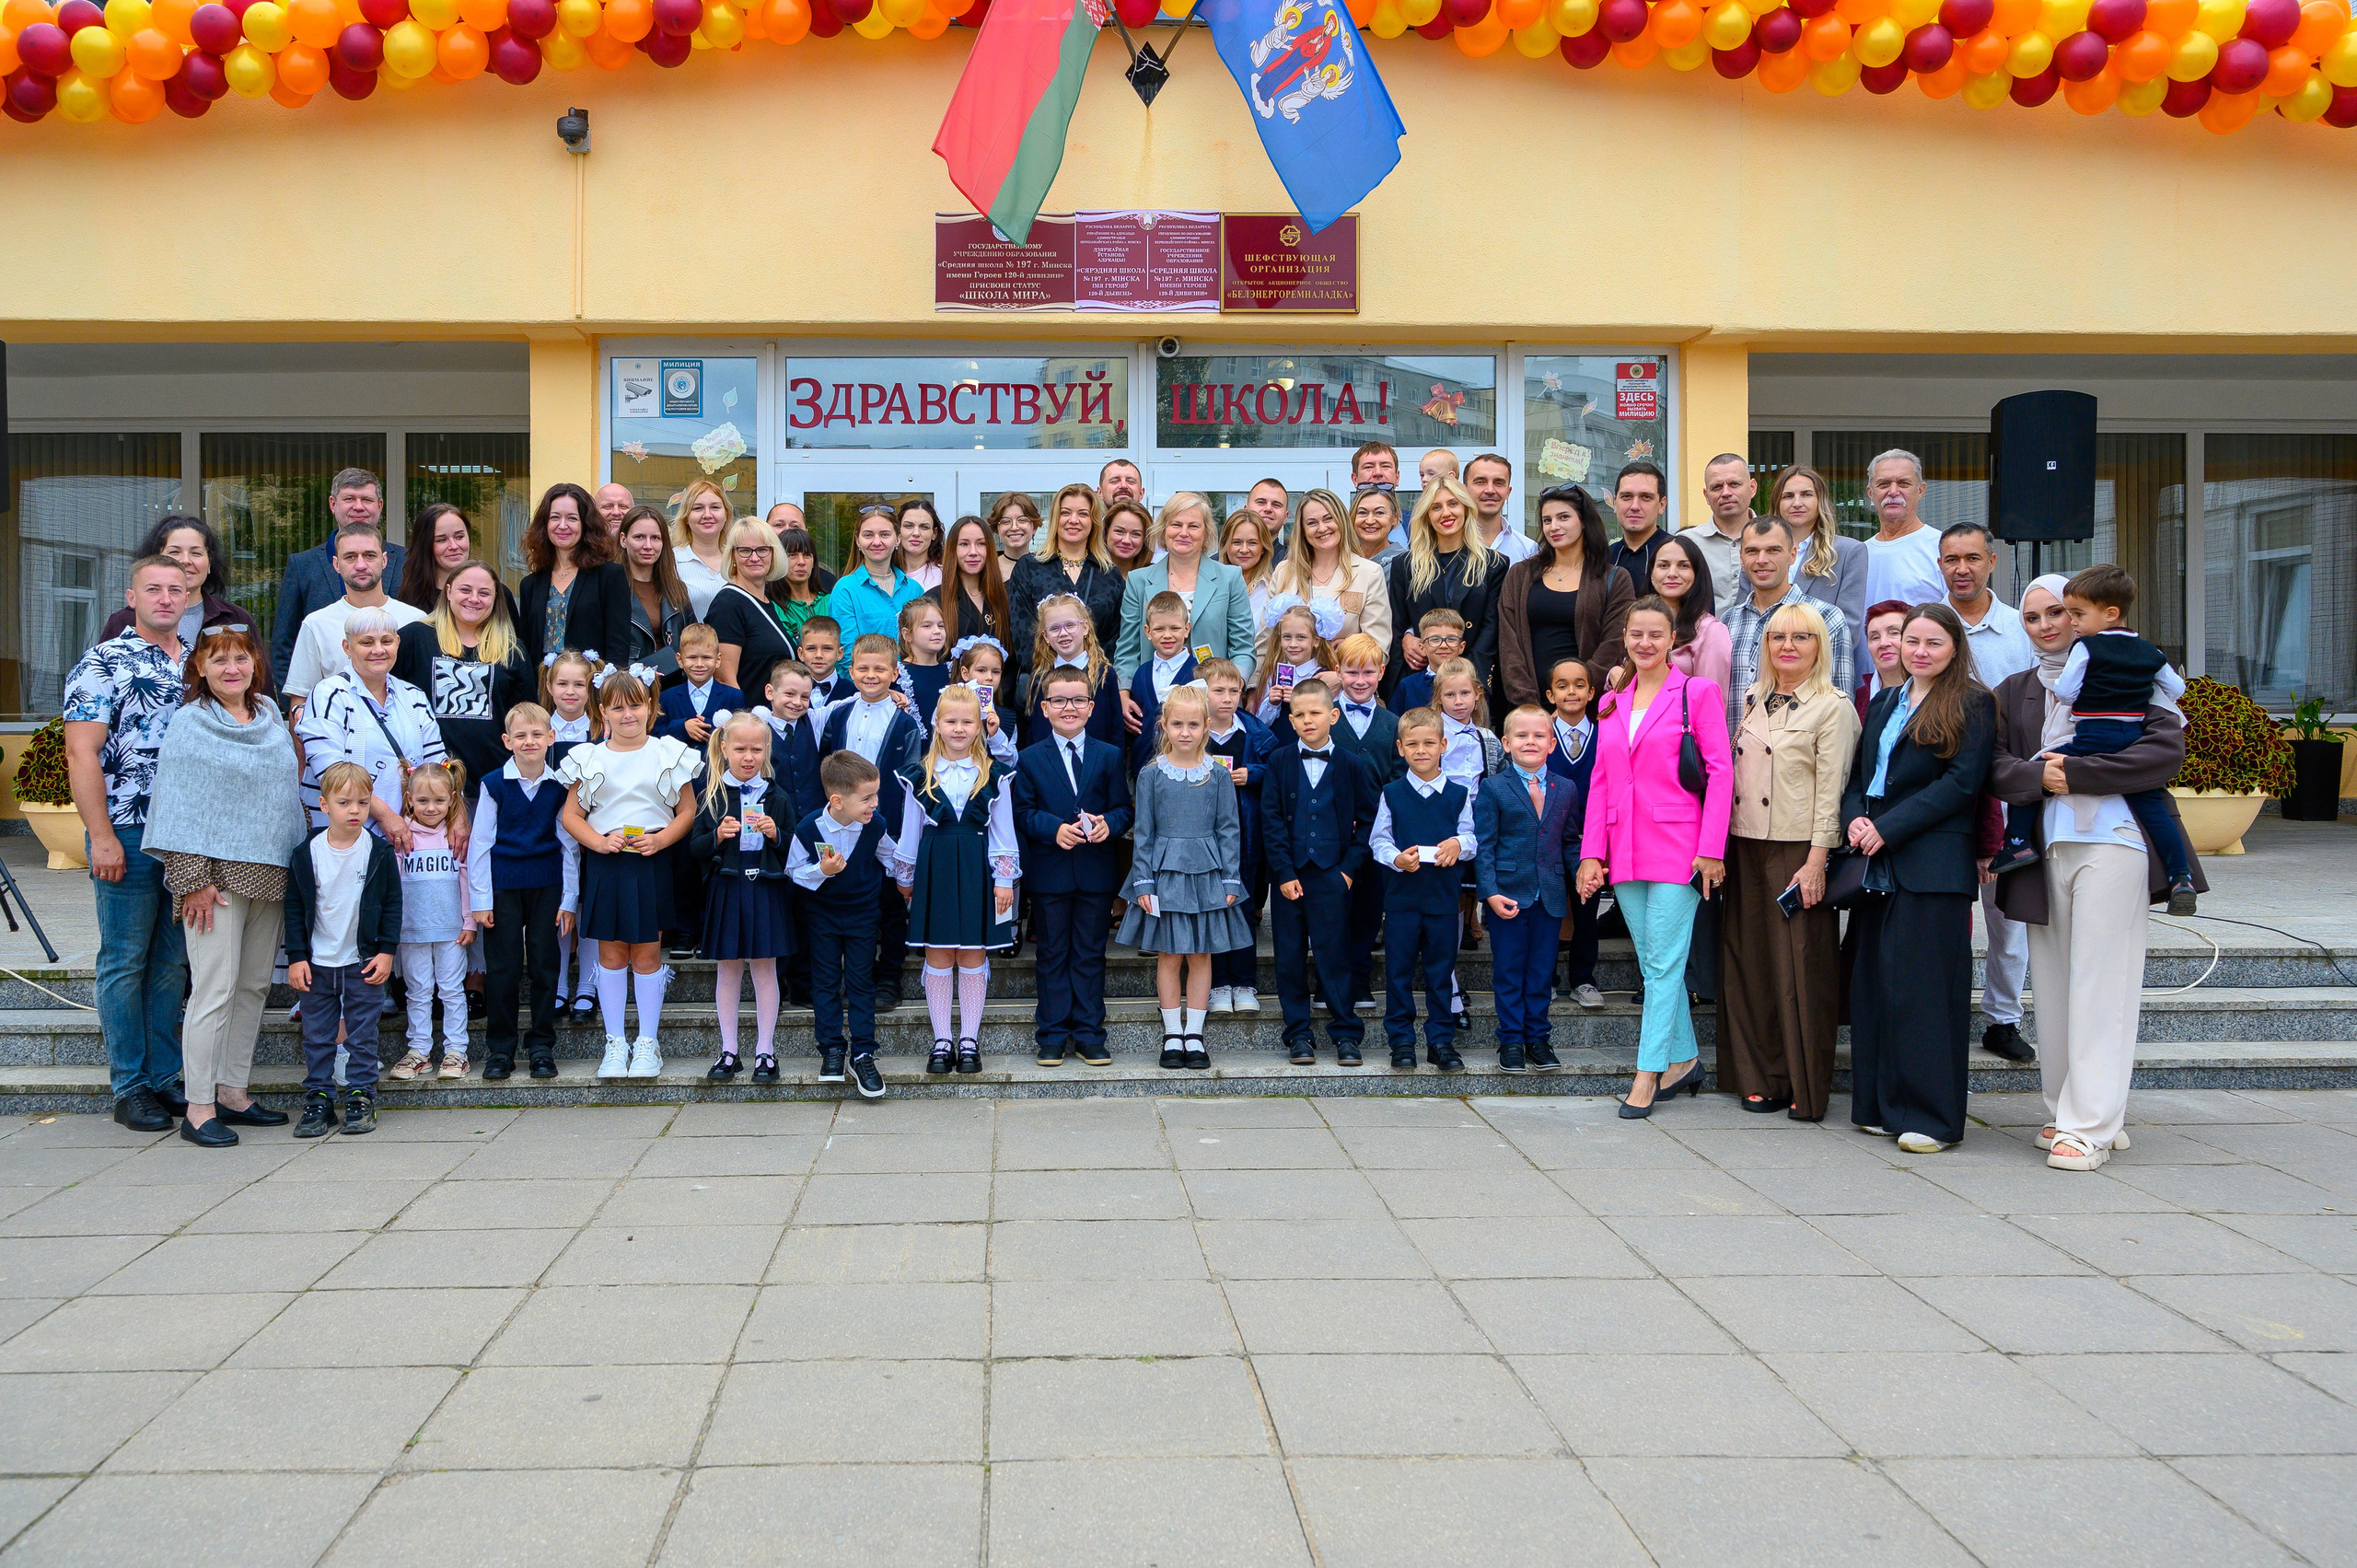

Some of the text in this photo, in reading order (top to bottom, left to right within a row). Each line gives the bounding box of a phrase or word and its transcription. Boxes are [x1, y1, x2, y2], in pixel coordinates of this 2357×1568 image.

[1244, 253, 1336, 262] ШЕФСТВУЮЩАЯ
[937, 261, 976, 269] «Средняя
[1016, 261, 1032, 269] 197
[1249, 265, 1330, 273] ОРГАНИЗАЦИЯ
[958, 291, 1051, 300] «ШКОЛА МИРА»
[1226, 289, 1353, 299] «БЕЛЭНЕРГОРЕМНАЛАДКА»
[1620, 392, 1655, 403] ЗДЕСЬ
[789, 371, 1125, 434] ЗДРАВСТВУЙ,
